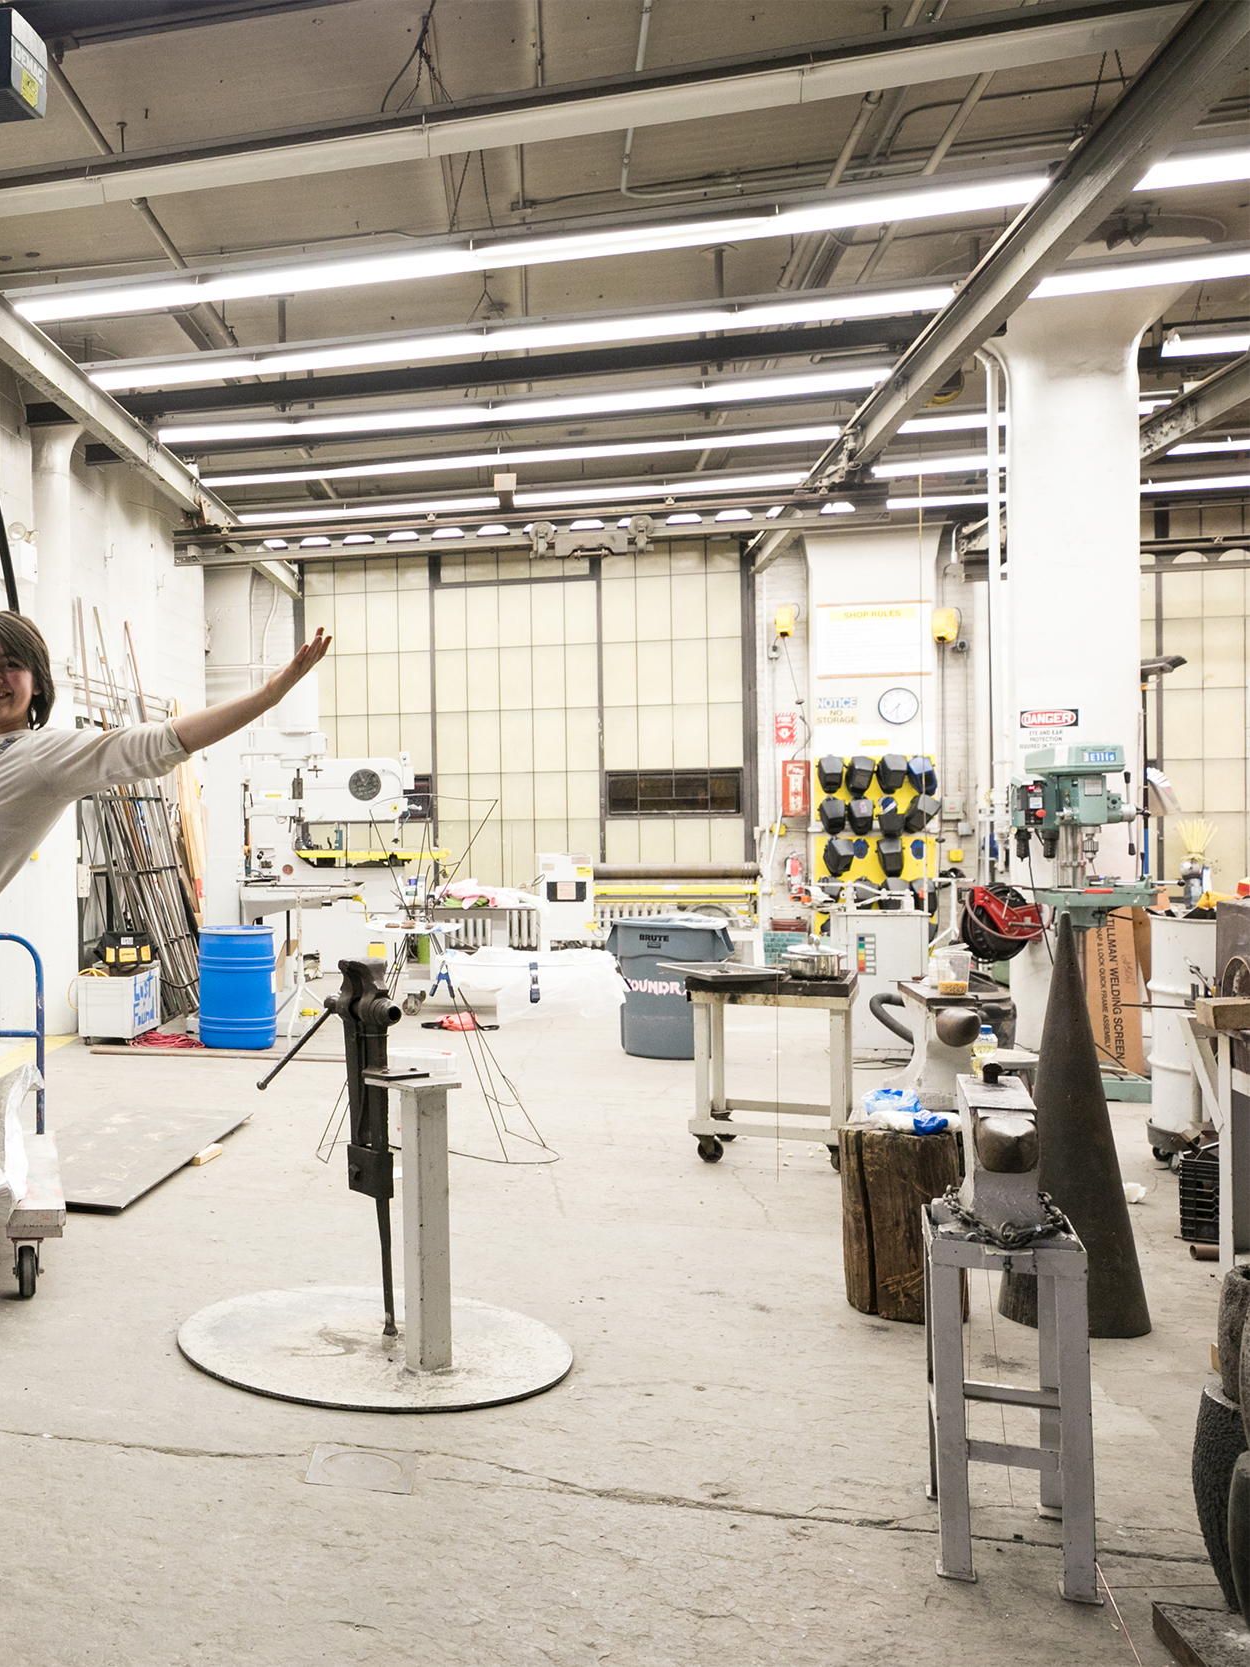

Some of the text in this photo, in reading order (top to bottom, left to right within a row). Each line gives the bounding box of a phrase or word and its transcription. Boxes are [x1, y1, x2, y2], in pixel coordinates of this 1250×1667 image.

[14, 42, 44, 86] DEMAG
[844, 610, 901, 620] SHOP RULES
[816, 698, 857, 709] NOTICE
[816, 716, 857, 724] STORAGE
[1024, 712, 1072, 725] DANGER
[1090, 752, 1115, 761] Ellis
[639, 934, 669, 942] BRUTE
[628, 979, 687, 996] OUNDR
[1110, 967, 1122, 1014] WELDING
[1102, 1014, 1111, 1049] ASSEMBLY
[1113, 1017, 1125, 1059] SCREEN
